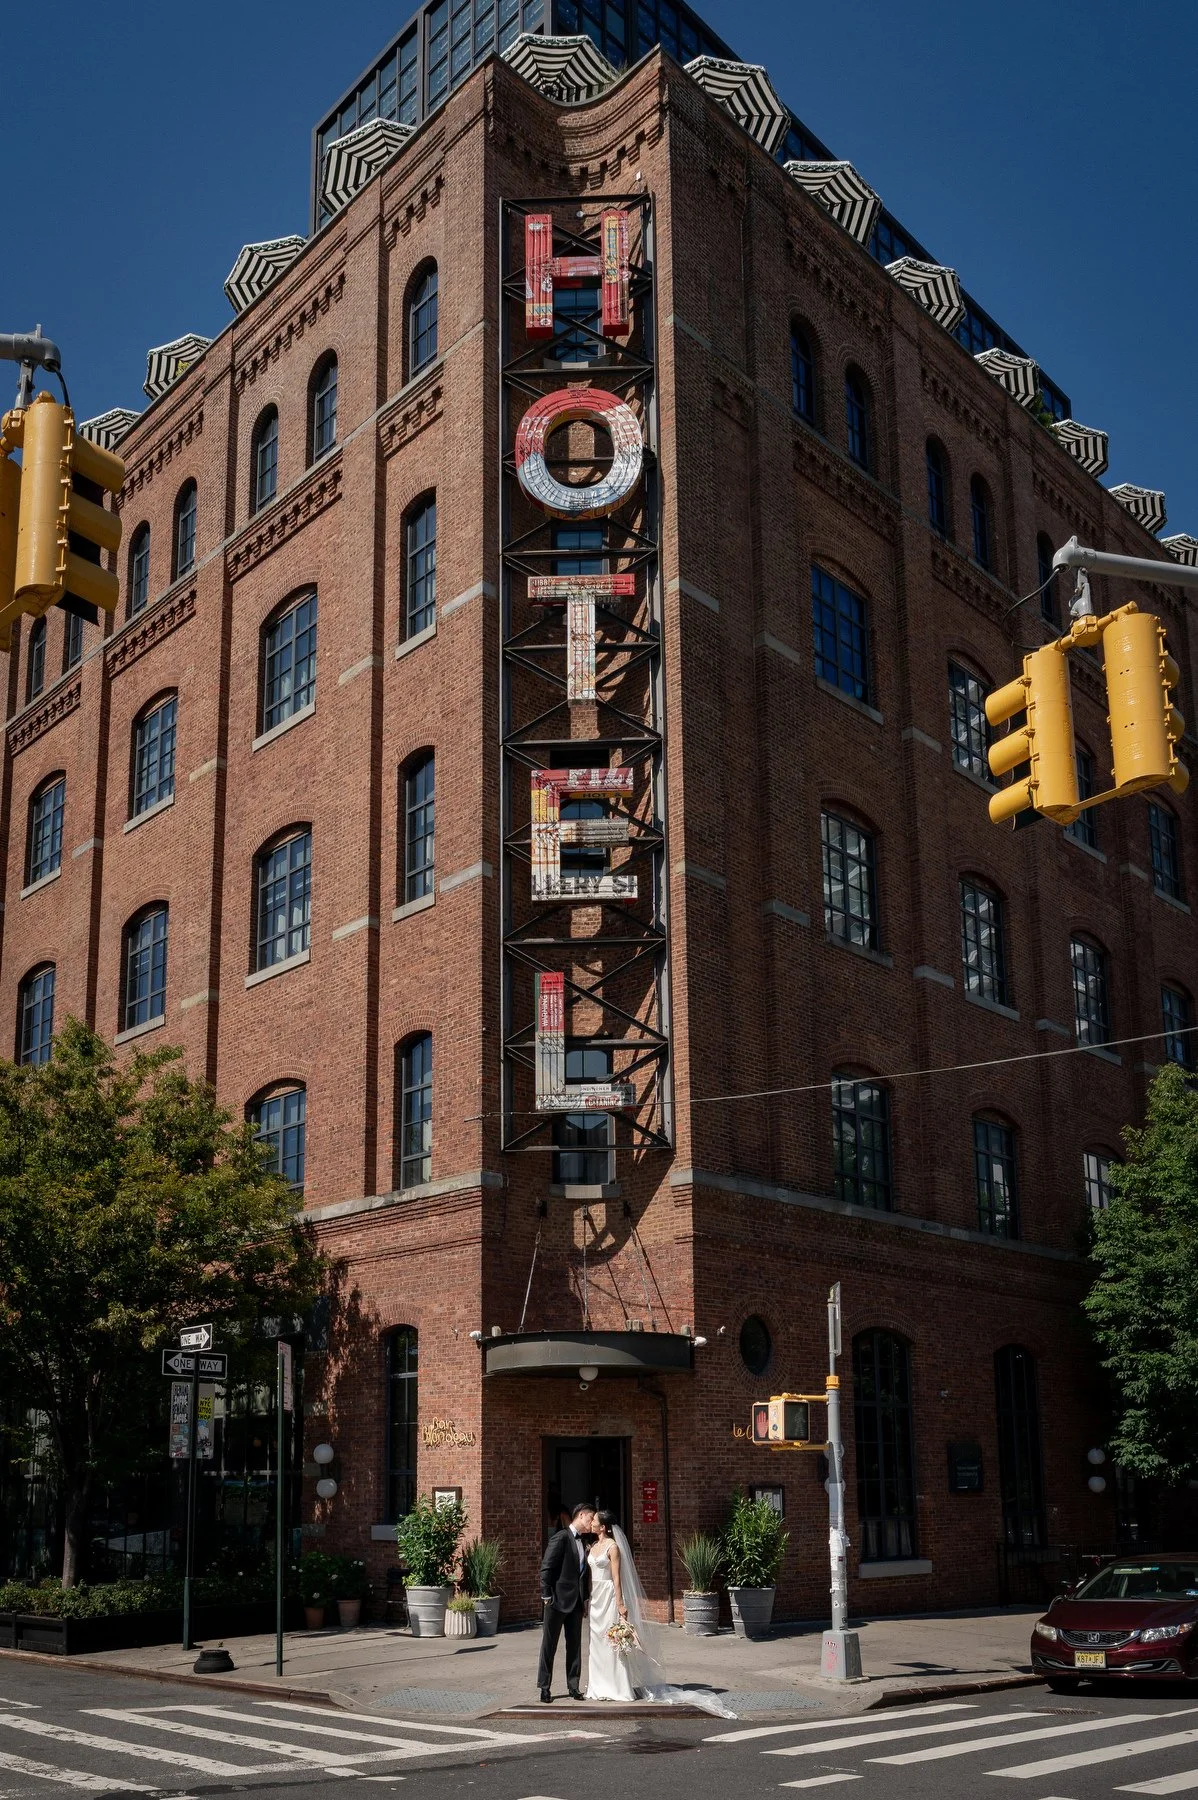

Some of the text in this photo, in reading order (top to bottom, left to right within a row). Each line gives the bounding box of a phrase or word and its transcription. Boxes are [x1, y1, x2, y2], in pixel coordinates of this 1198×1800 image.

[515, 210, 643, 1110] HOTEL
[181, 1332, 207, 1346] ONE WAY
[173, 1358, 219, 1370] ONE WAY
[433, 1416, 453, 1430] Bar
